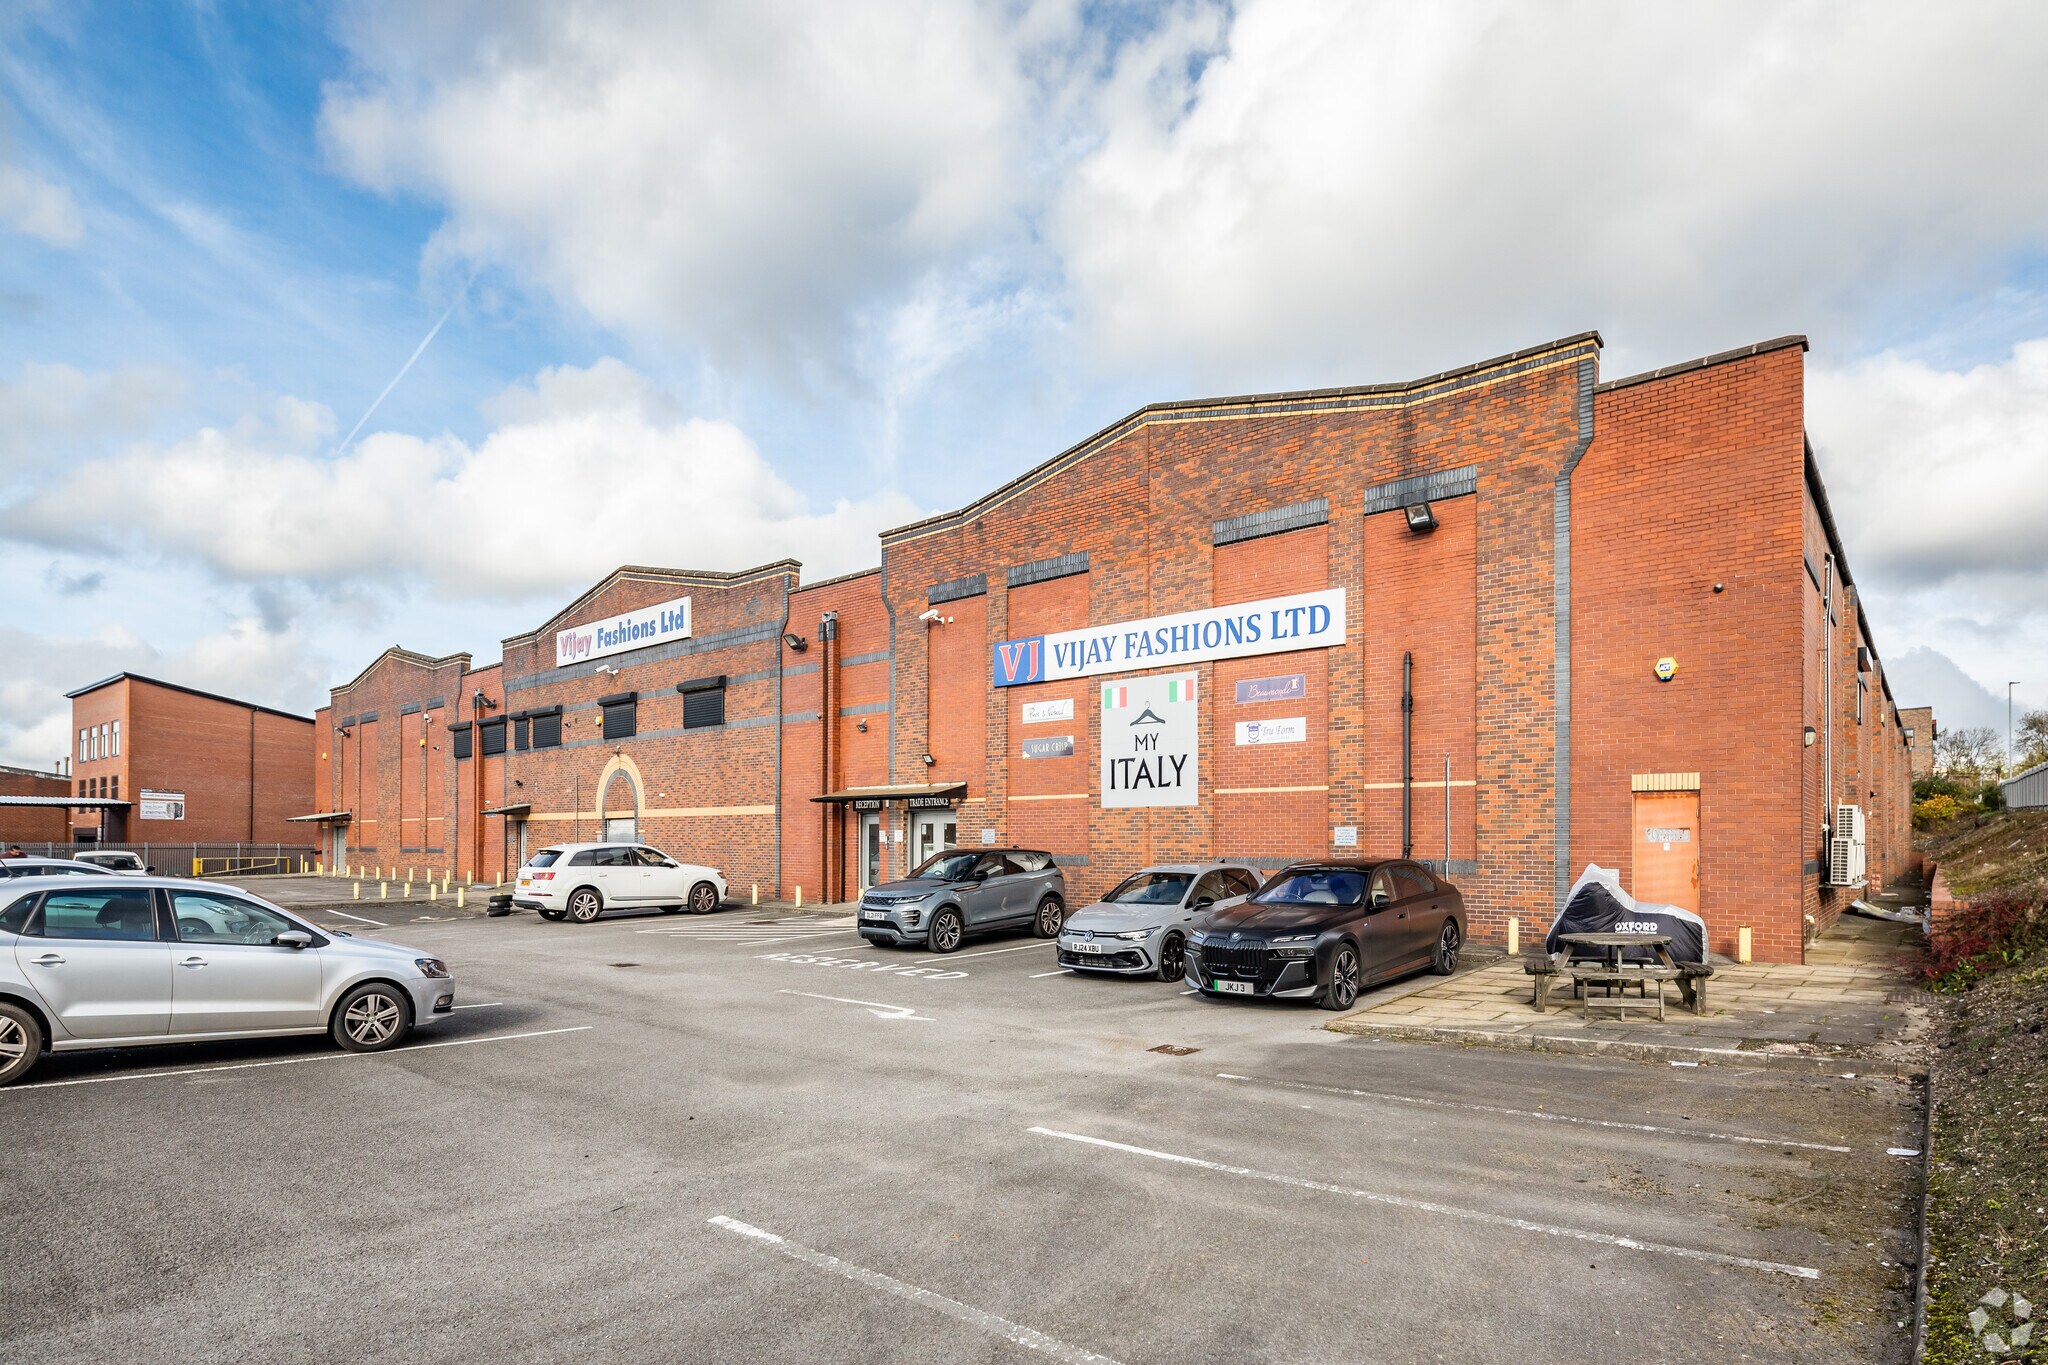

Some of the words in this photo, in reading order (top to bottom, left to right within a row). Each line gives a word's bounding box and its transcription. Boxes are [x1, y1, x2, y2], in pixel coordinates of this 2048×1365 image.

[559, 631, 592, 660] Vijay
[597, 618, 656, 649] Fashions
[660, 605, 684, 633] Ltd
[1053, 635, 1117, 671] VIJAY
[1124, 614, 1261, 659] FASHIONS
[1271, 604, 1331, 640] LTD
[999, 640, 1042, 683] VJ
[1031, 743, 1050, 754] SUGAR
[1134, 732, 1159, 752] MY
[1110, 753, 1188, 790] ITALY
[855, 800, 880, 809] RECEPTION
[909, 798, 924, 807] TRADE
[924, 797, 949, 807] ENTRANCE
[1614, 921, 1658, 932] OXFORD
[754, 953, 970, 980] RESERVED
[1225, 982, 1239, 992] JKJ
[1240, 983, 1246, 993] 3
